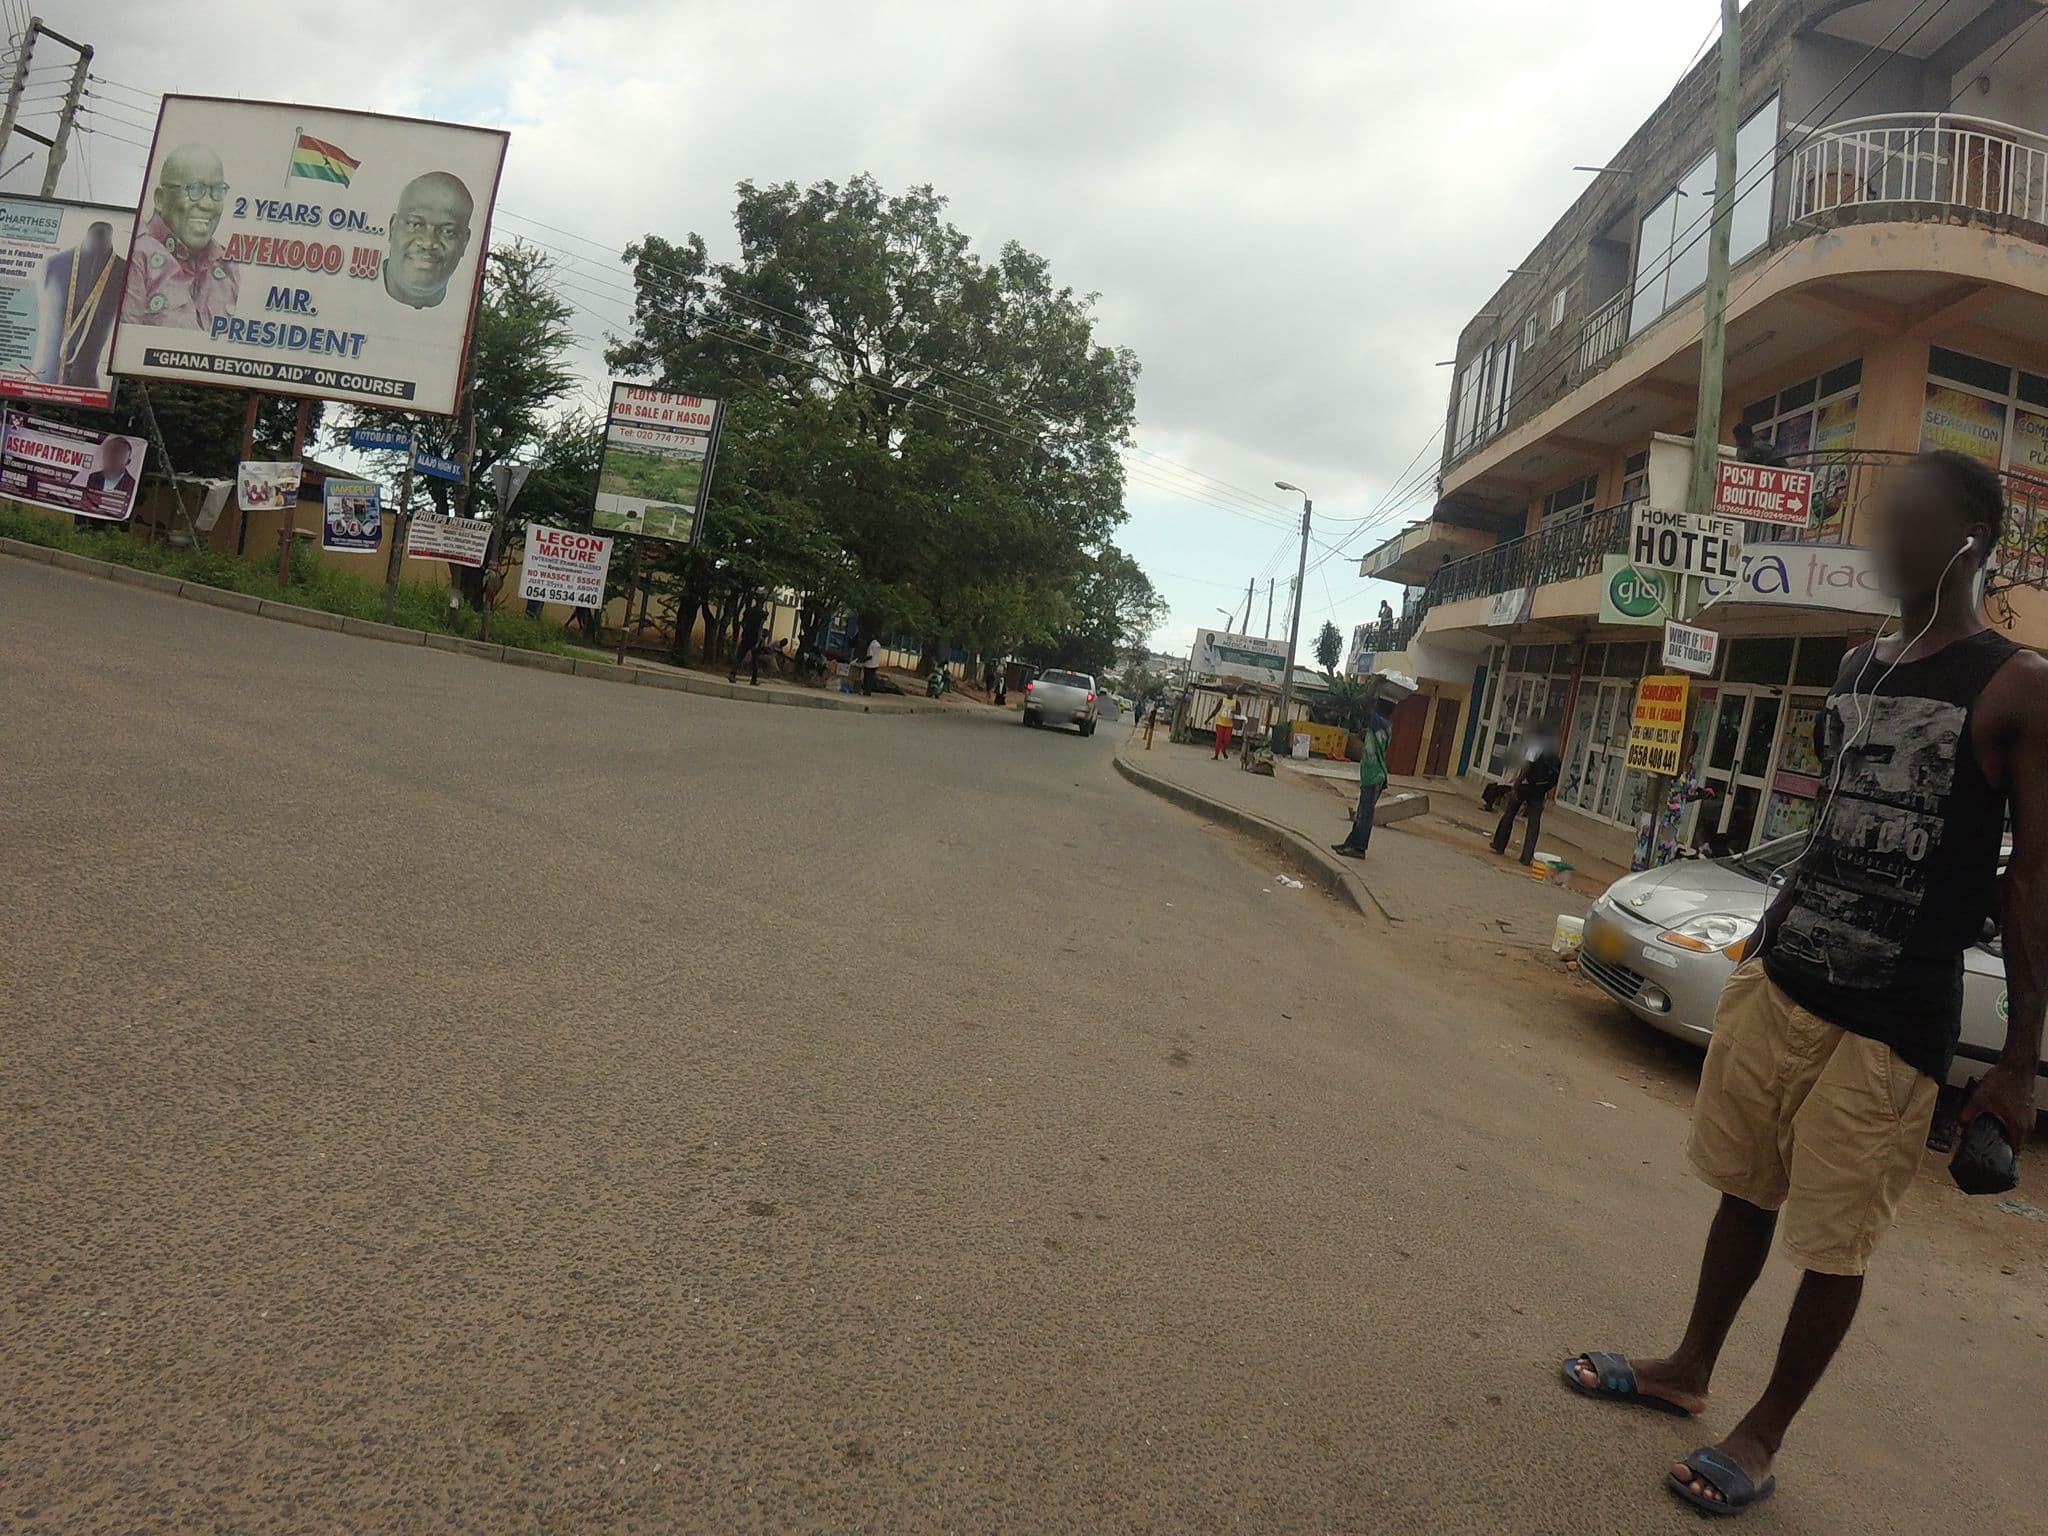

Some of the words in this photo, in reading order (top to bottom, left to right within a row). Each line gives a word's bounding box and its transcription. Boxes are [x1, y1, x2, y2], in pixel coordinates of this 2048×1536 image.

[233, 197, 247, 216] 2
[255, 199, 321, 224] YEARS
[329, 208, 385, 233] ON...
[224, 233, 343, 272] AYEKOOO
[349, 246, 380, 278] !!!
[265, 286, 317, 314] MR.
[211, 316, 366, 357] PRESIDENT
[214, 358, 273, 377] BEYOND
[314, 371, 336, 386] ON
[340, 375, 404, 397] COURSE
[627, 388, 657, 403] PLOTS
[661, 392, 672, 404] OF
[676, 394, 702, 408] LAND
[613, 402, 632, 415] FOR
[635, 405, 659, 419] SALE
[661, 409, 674, 421] AT
[676, 411, 710, 426] KASOA
[355, 429, 394, 444] KOTOBABI
[636, 430, 653, 440] 020
[417, 454, 440, 468] ALAJO
[439, 458, 452, 471] HIGH
[1722, 465, 1754, 487] POSH
[1759, 471, 1777, 488] BY
[1781, 473, 1807, 494] VEE
[1722, 485, 1784, 511] BOUTIQUE
[415, 510, 447, 525] PHILIPS
[448, 517, 493, 532] INSTITUTE
[1641, 509, 1687, 528] HOME
[1697, 518, 1733, 536] LIFE
[535, 529, 603, 552] LEGON
[1635, 525, 1737, 578] HOTEL
[539, 543, 596, 563] MATURE
[527, 569, 538, 577] NO
[540, 571, 570, 582] WASSCE
[577, 576, 601, 586] SSSCE
[526, 586, 546, 599] 054
[549, 589, 575, 602] 9534
[578, 592, 597, 605] 440
[1669, 626, 1692, 646] WHAT
[1692, 632, 1700, 647] IF
[1700, 632, 1714, 650] YOU
[1669, 643, 1682, 658] DIE
[1683, 646, 1712, 664] TODAY?
[1628, 743, 1648, 767] 0558
[1664, 749, 1677, 772] 441
